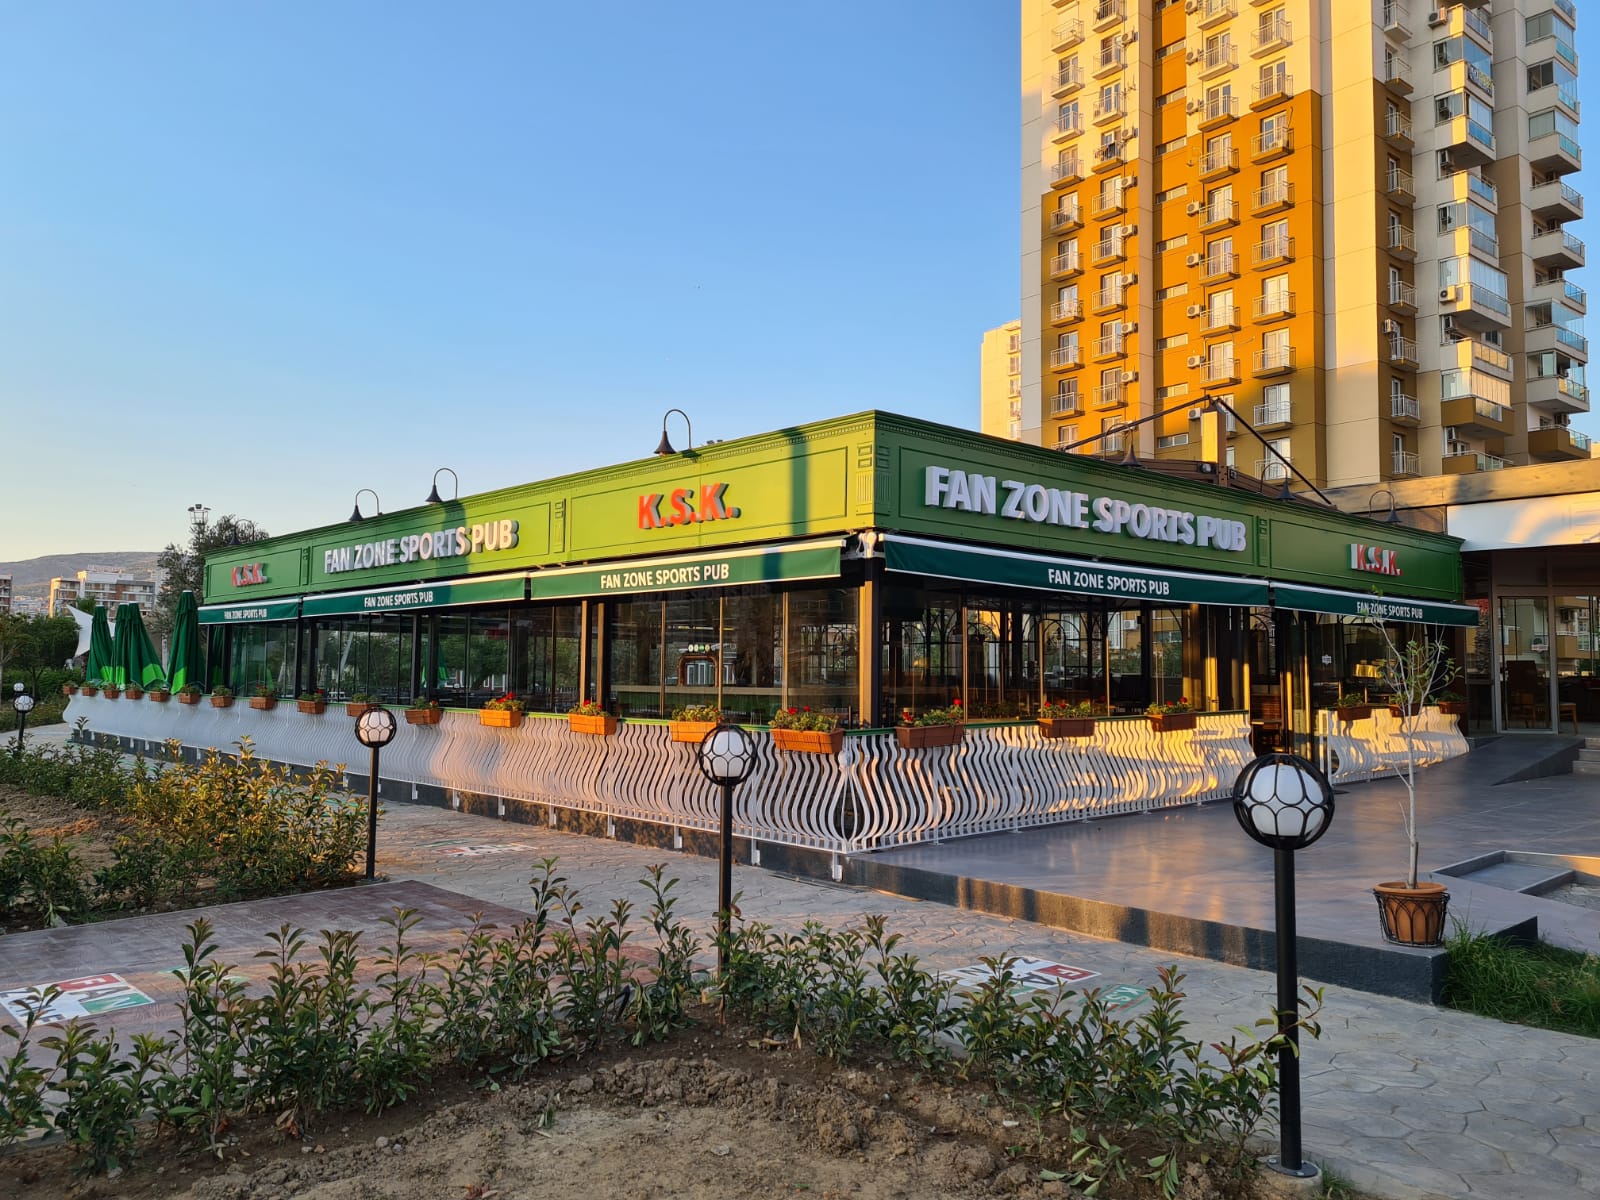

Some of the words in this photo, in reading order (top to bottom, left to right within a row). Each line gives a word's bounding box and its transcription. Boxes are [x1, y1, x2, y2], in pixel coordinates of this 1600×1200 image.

[638, 483, 741, 529] K.S.K.
[925, 466, 997, 514] FAN
[1001, 480, 1089, 529] ZONE
[1092, 497, 1195, 545] SPORTS
[1197, 515, 1246, 551] PUB
[323, 547, 350, 574] FAN
[352, 538, 398, 569] ZONE
[400, 527, 471, 563] SPORTS
[470, 520, 519, 553] PUB
[1351, 543, 1403, 576] K.S.K.
[232, 562, 267, 587] K.S.K.
[600, 574, 621, 590] FAN
[623, 571, 653, 588] ZONE
[655, 567, 700, 585] SPORTS
[703, 563, 730, 581] PUB
[1048, 568, 1071, 585] FAN
[1074, 572, 1104, 589] ZONE
[1107, 575, 1147, 593] SPORTS
[1149, 580, 1170, 595] PUB
[364, 597, 377, 608] FAN
[377, 594, 394, 607] ZONE
[394, 592, 419, 606] SPORTS
[420, 591, 434, 603] PUB
[1356, 601, 1370, 614] FAN
[1370, 603, 1387, 616] ZONE
[1388, 605, 1411, 618] SPORTS
[1412, 608, 1423, 619] PUB
[224, 611, 232, 620] FAN
[233, 610, 242, 619] ZONE
[242, 609, 257, 619] SPORTS
[258, 608, 267, 618] PUB
